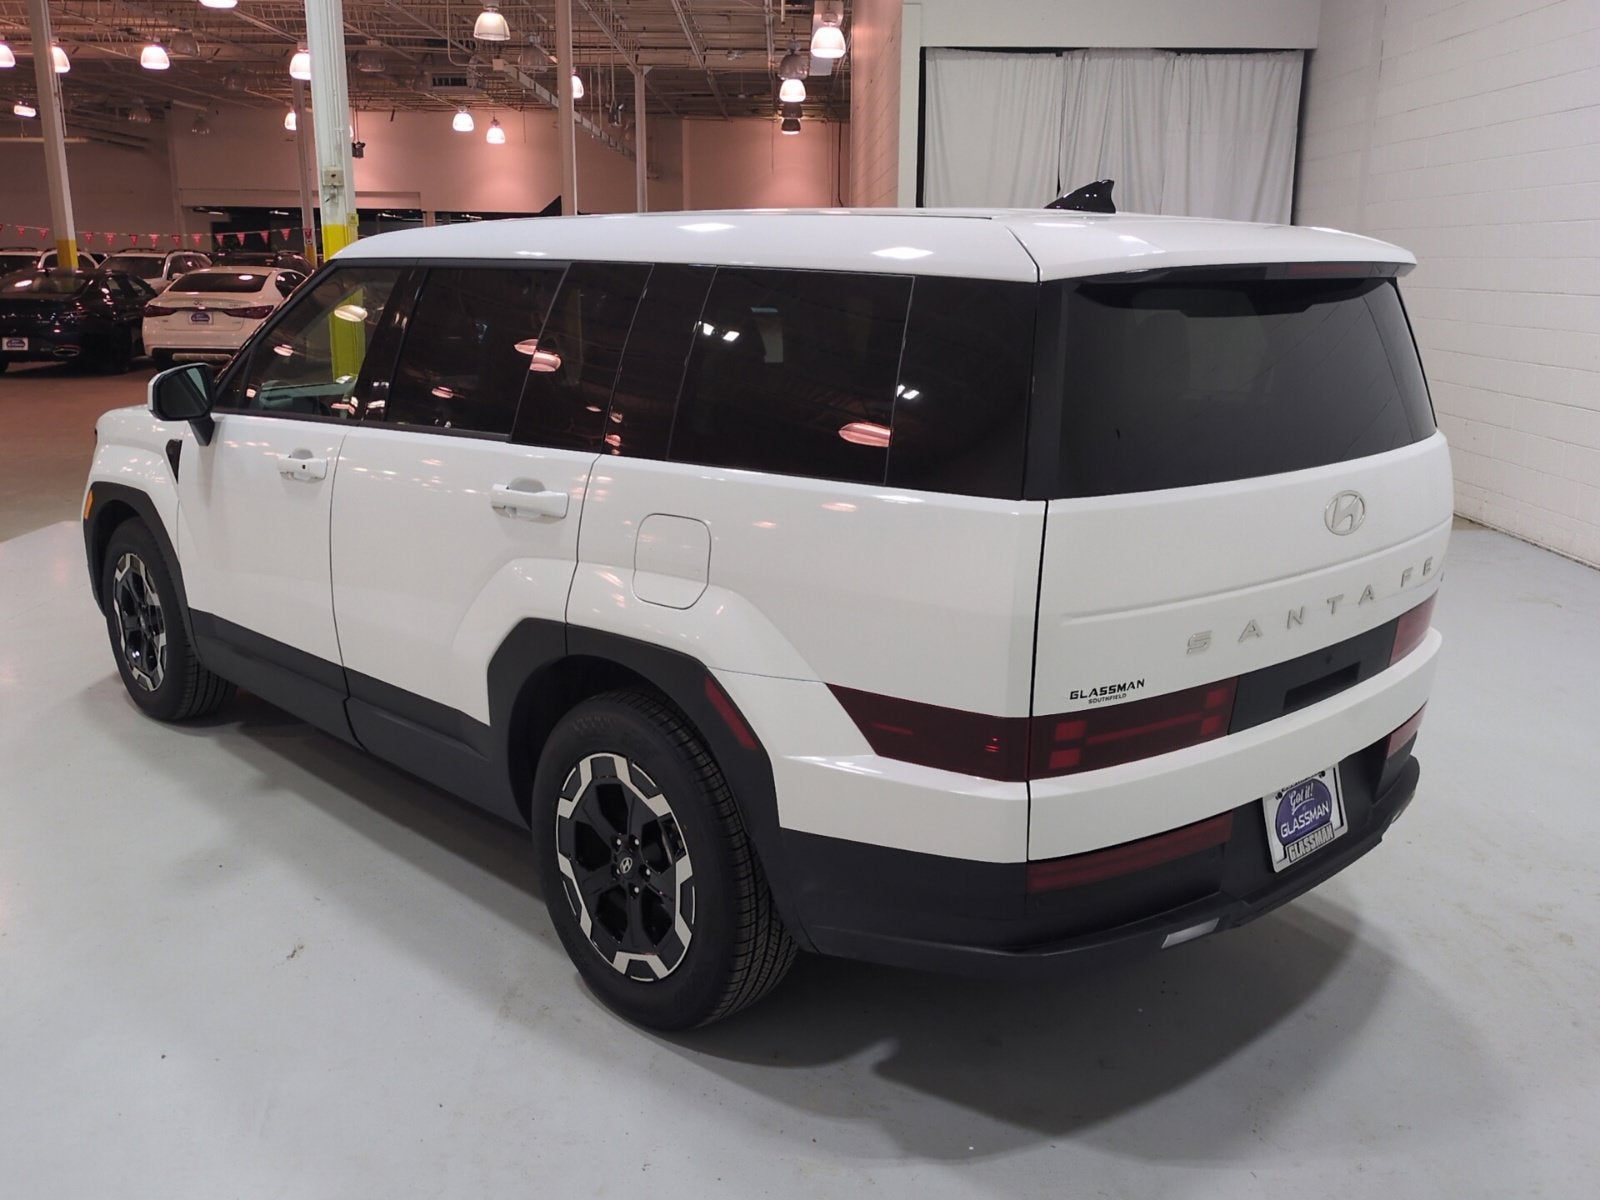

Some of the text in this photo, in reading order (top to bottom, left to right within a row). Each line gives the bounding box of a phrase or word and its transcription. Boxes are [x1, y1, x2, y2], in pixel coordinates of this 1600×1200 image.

[1186, 556, 1434, 655] SANTA FE
[1069, 678, 1145, 700] GLASSMAN
[1088, 693, 1127, 704] SOUTHFIELD
[1280, 801, 1329, 838] GLASSMAN
[1288, 825, 1334, 861] GLASSMAN
